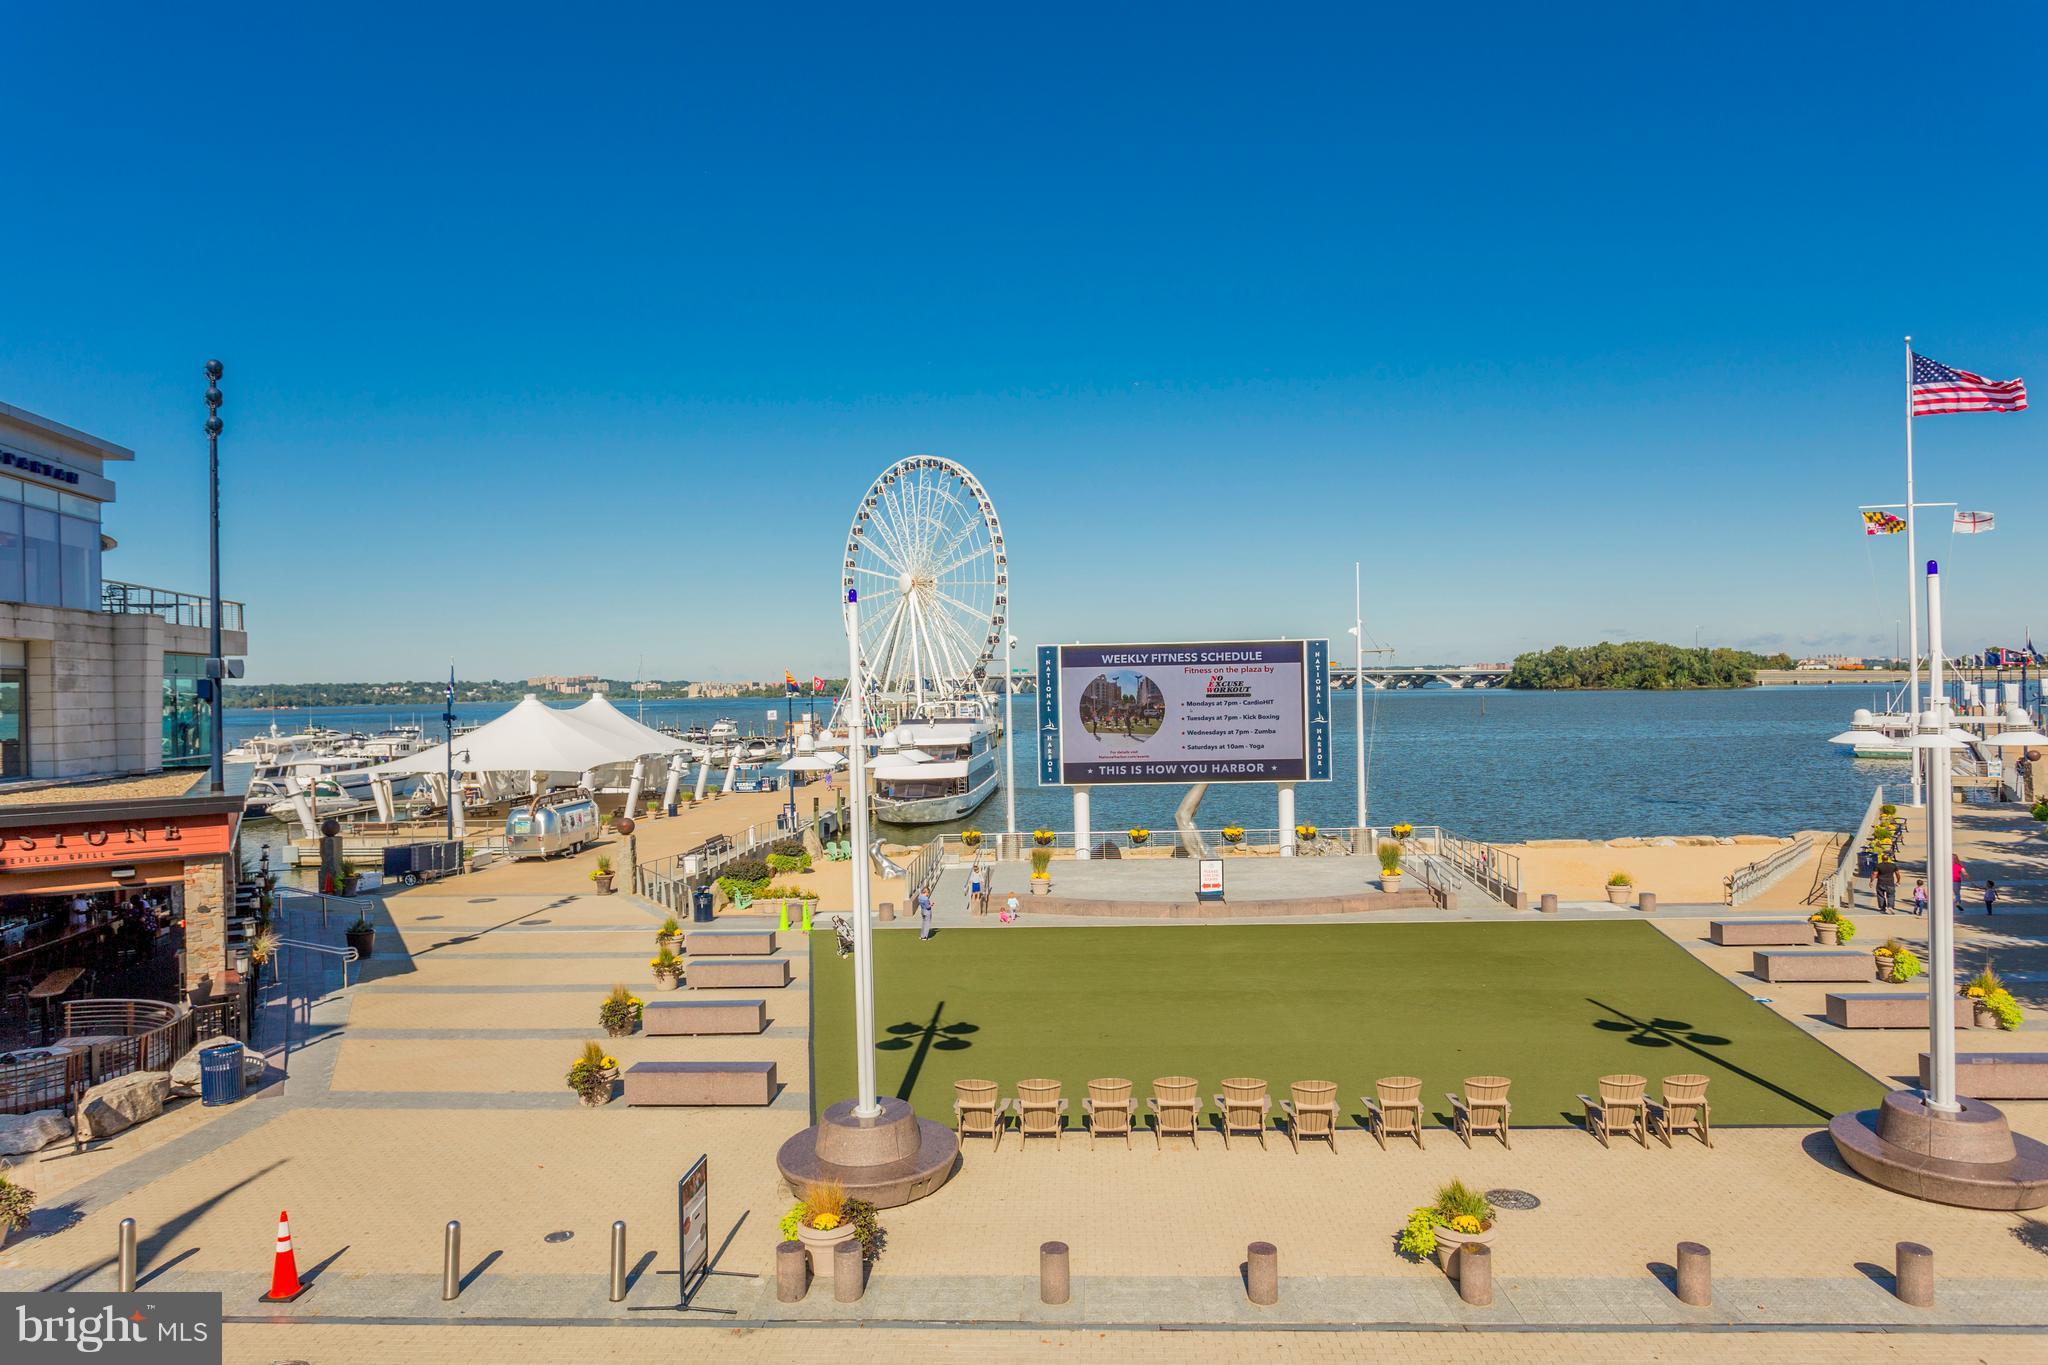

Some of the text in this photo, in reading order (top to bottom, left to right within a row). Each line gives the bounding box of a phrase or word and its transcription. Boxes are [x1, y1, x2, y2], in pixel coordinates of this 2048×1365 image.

[1101, 651, 1263, 664] WEEKLY FITNESS SCHEDULE
[1184, 666, 1212, 674] Fitness
[1226, 665, 1239, 673] the
[1240, 666, 1262, 674] plaza
[1264, 665, 1274, 674] by
[1099, 763, 1264, 775] THIS IS HOW YOU HARBOR
[0, 825, 182, 850] STONE
[69, 852, 105, 861] GRILL
